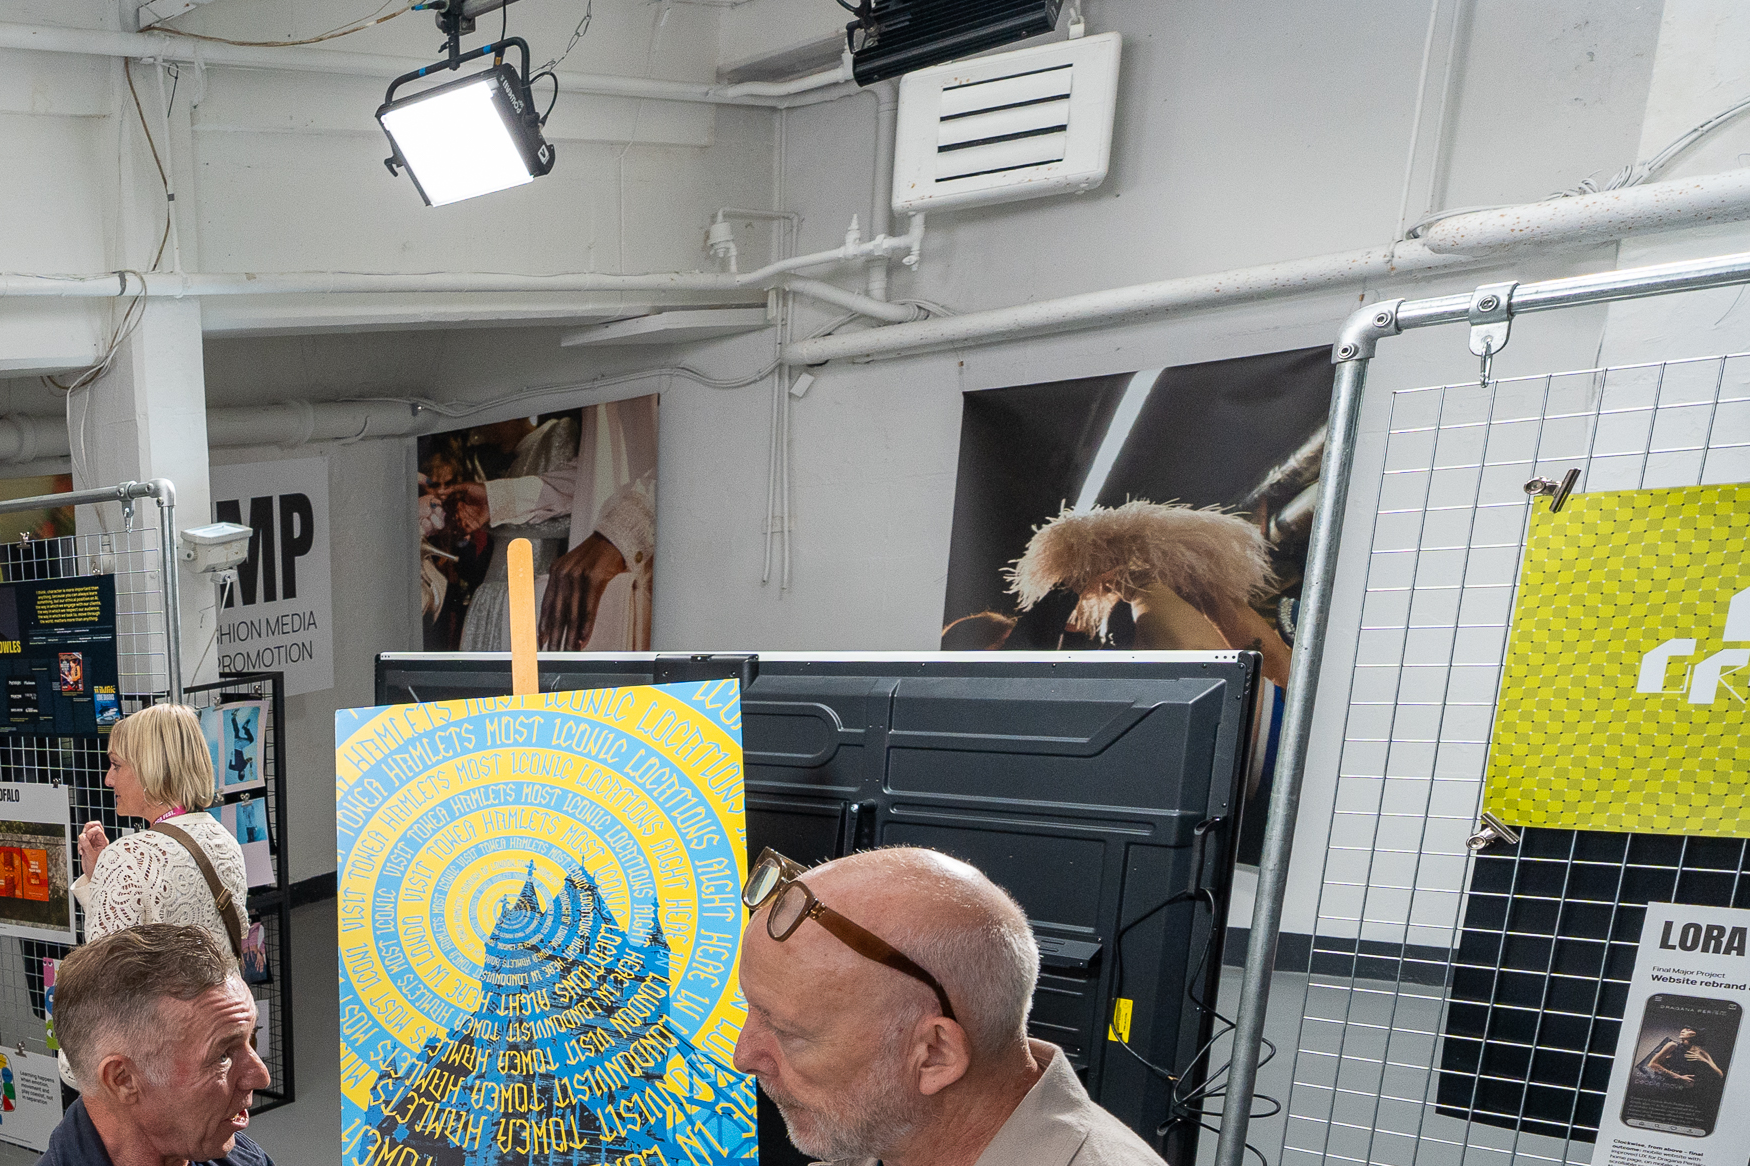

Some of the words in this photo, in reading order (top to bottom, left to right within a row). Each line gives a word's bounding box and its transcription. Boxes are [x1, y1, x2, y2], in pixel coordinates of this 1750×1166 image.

[266, 611, 318, 637] MEDIA
[486, 715, 544, 746] MOST
[552, 717, 627, 763] ICONIC
[454, 753, 502, 785] MOST
[511, 751, 573, 780] ICONIC
[522, 781, 562, 805] MOST
[560, 824, 605, 862] MOST
[1659, 920, 1747, 956] LORA
[1651, 974, 1697, 986] Website
[1700, 980, 1747, 991] rebrand
[1652, 965, 1671, 973] Final
[1672, 968, 1695, 976] Major
[1696, 970, 1726, 979] Project
[20, 1070, 37, 1080] Learning
